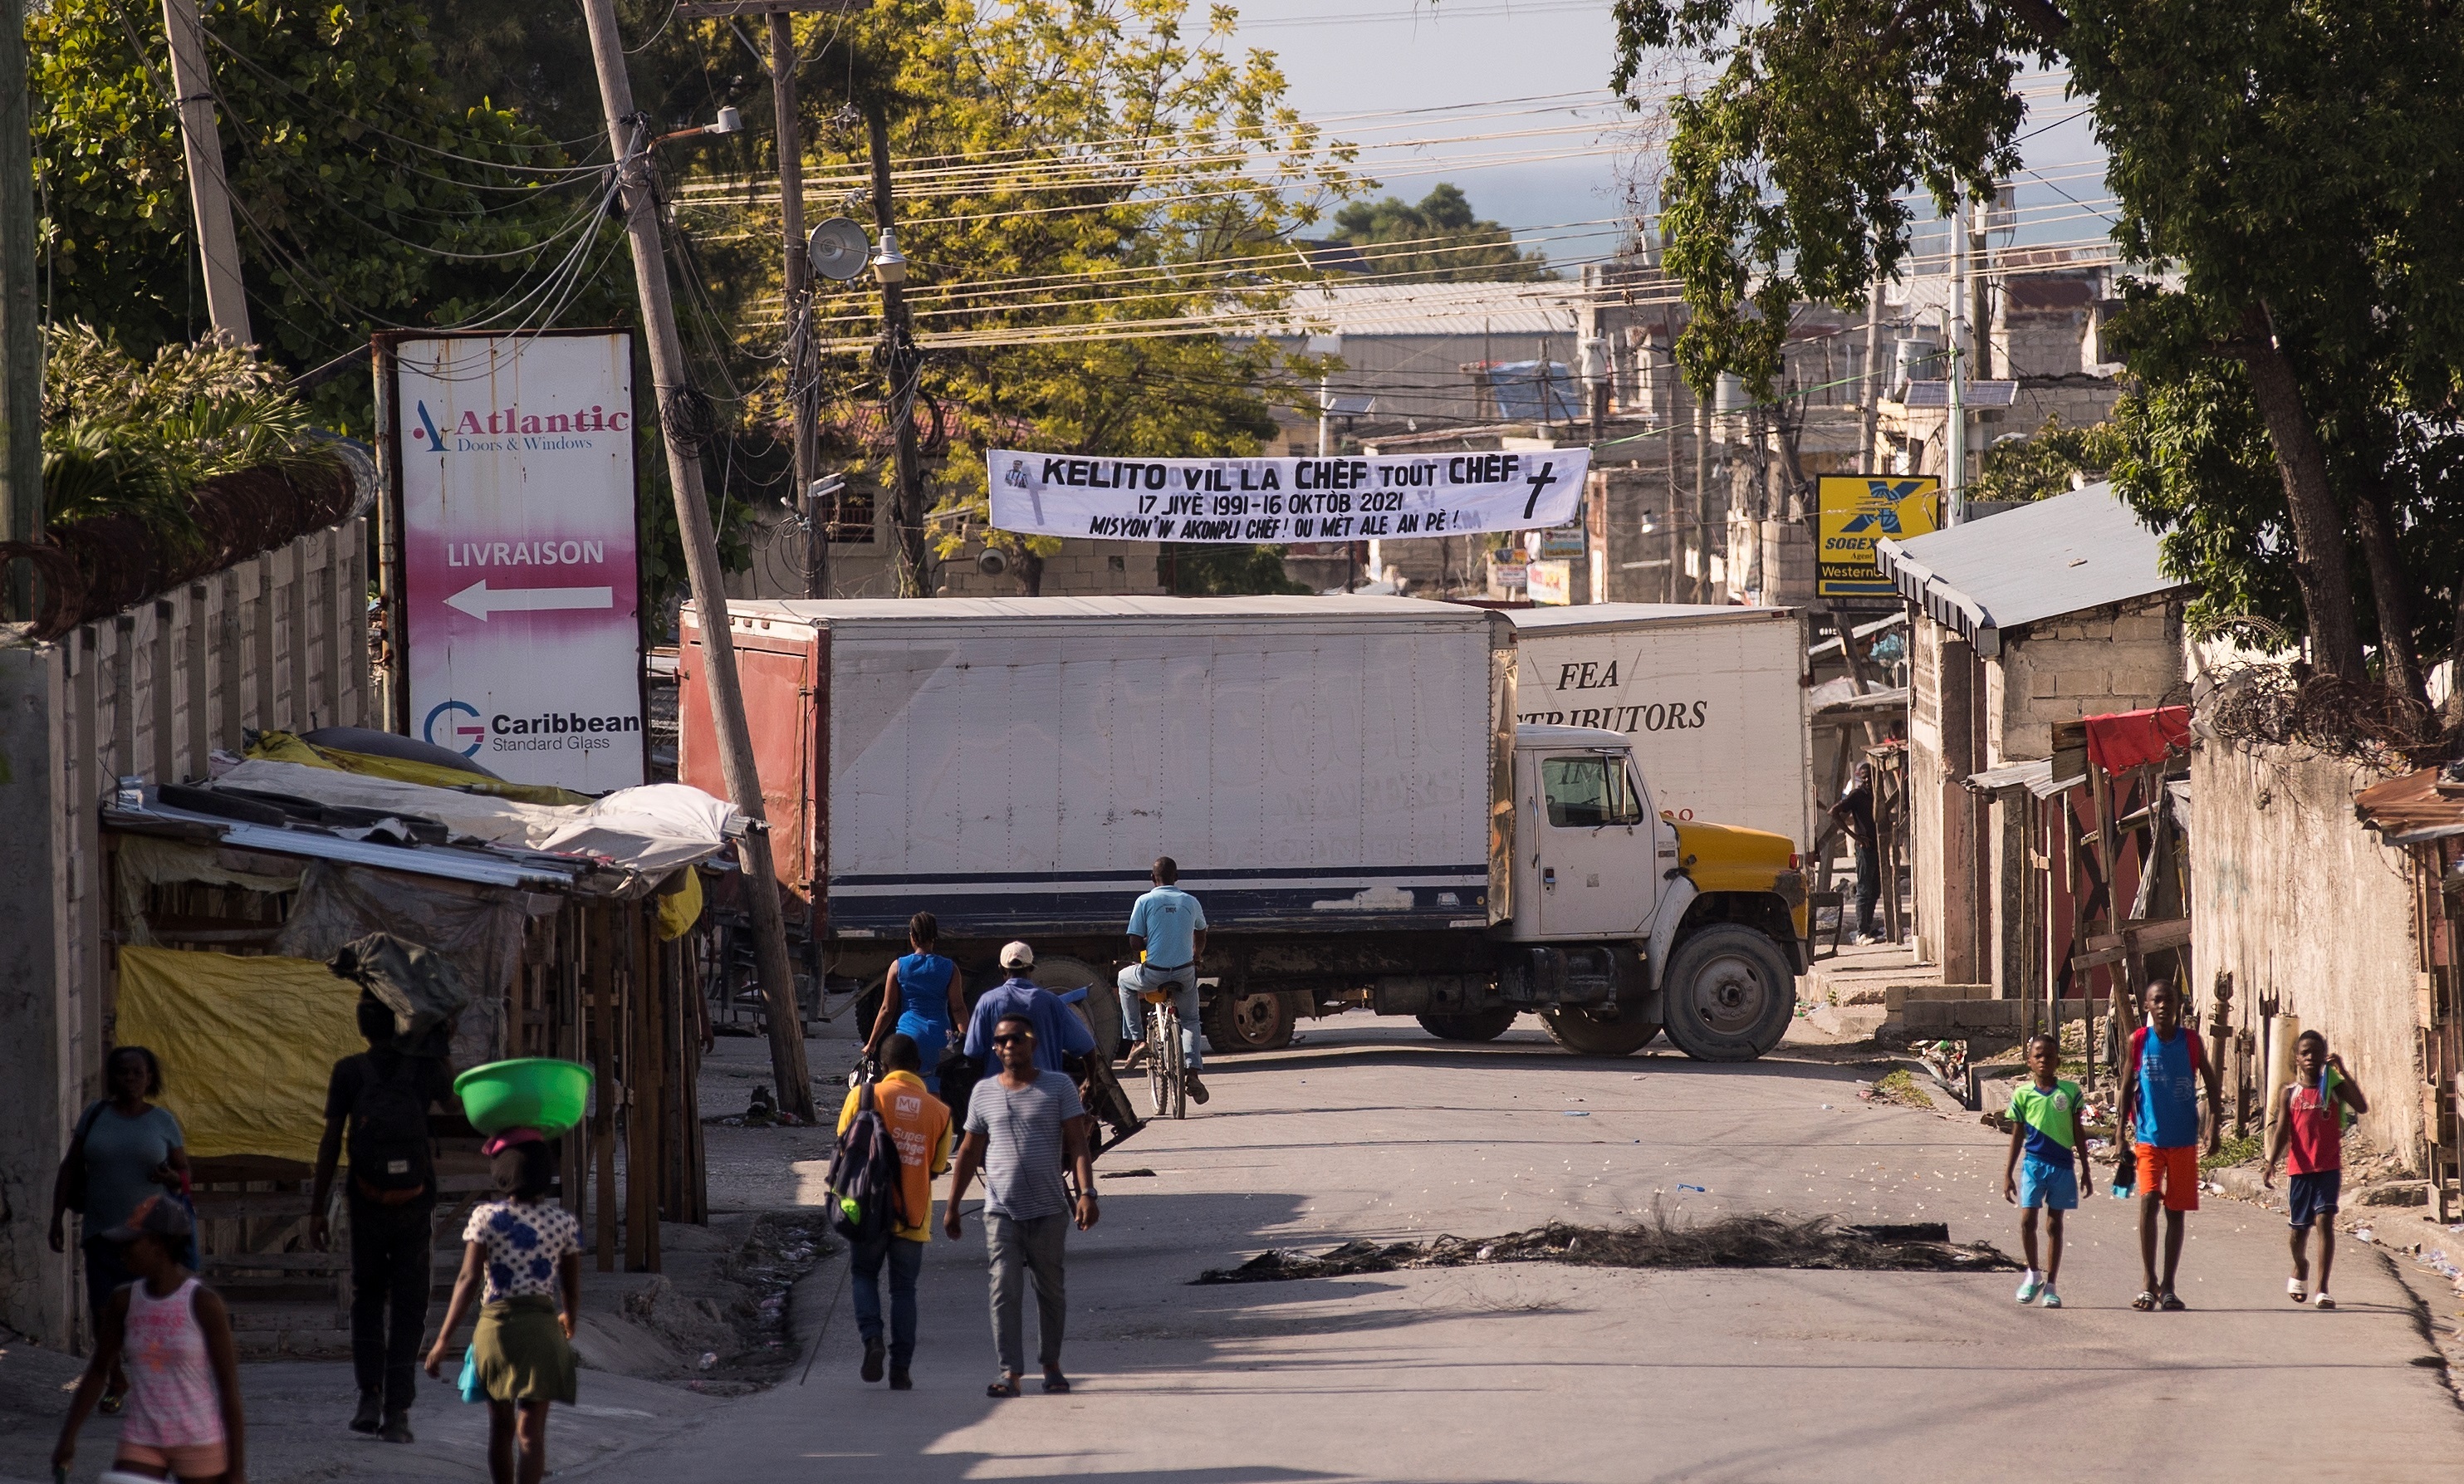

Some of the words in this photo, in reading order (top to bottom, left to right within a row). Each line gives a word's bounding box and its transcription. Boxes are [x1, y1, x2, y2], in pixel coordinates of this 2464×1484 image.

[454, 405, 629, 435] Atlantic
[458, 438, 502, 452] Doors
[507, 438, 520, 452] &
[523, 436, 592, 451] Windows
[1041, 458, 1166, 491] KELITO
[1295, 458, 1368, 490] CHÈF
[1379, 464, 1438, 488] TOUT
[1139, 495, 1158, 514] 17
[1161, 492, 1204, 516] JIYÈ
[1288, 490, 1351, 514] OKTÒB
[1359, 492, 1403, 512] 2021
[1295, 517, 1314, 538] OU
[1320, 513, 1354, 537] MÈT
[1359, 516, 1389, 536] ALE
[1396, 513, 1419, 534] AN
[448, 540, 605, 568] LIVRAISON
[1825, 536, 1879, 550] SOGEX
[1851, 552, 1873, 561] Agent
[1555, 660, 1619, 690] FEA
[492, 713, 639, 735] Caribbean
[492, 736, 562, 752] Standard
[566, 735, 610, 750] Glass
[892, 1127, 926, 1143] Super
